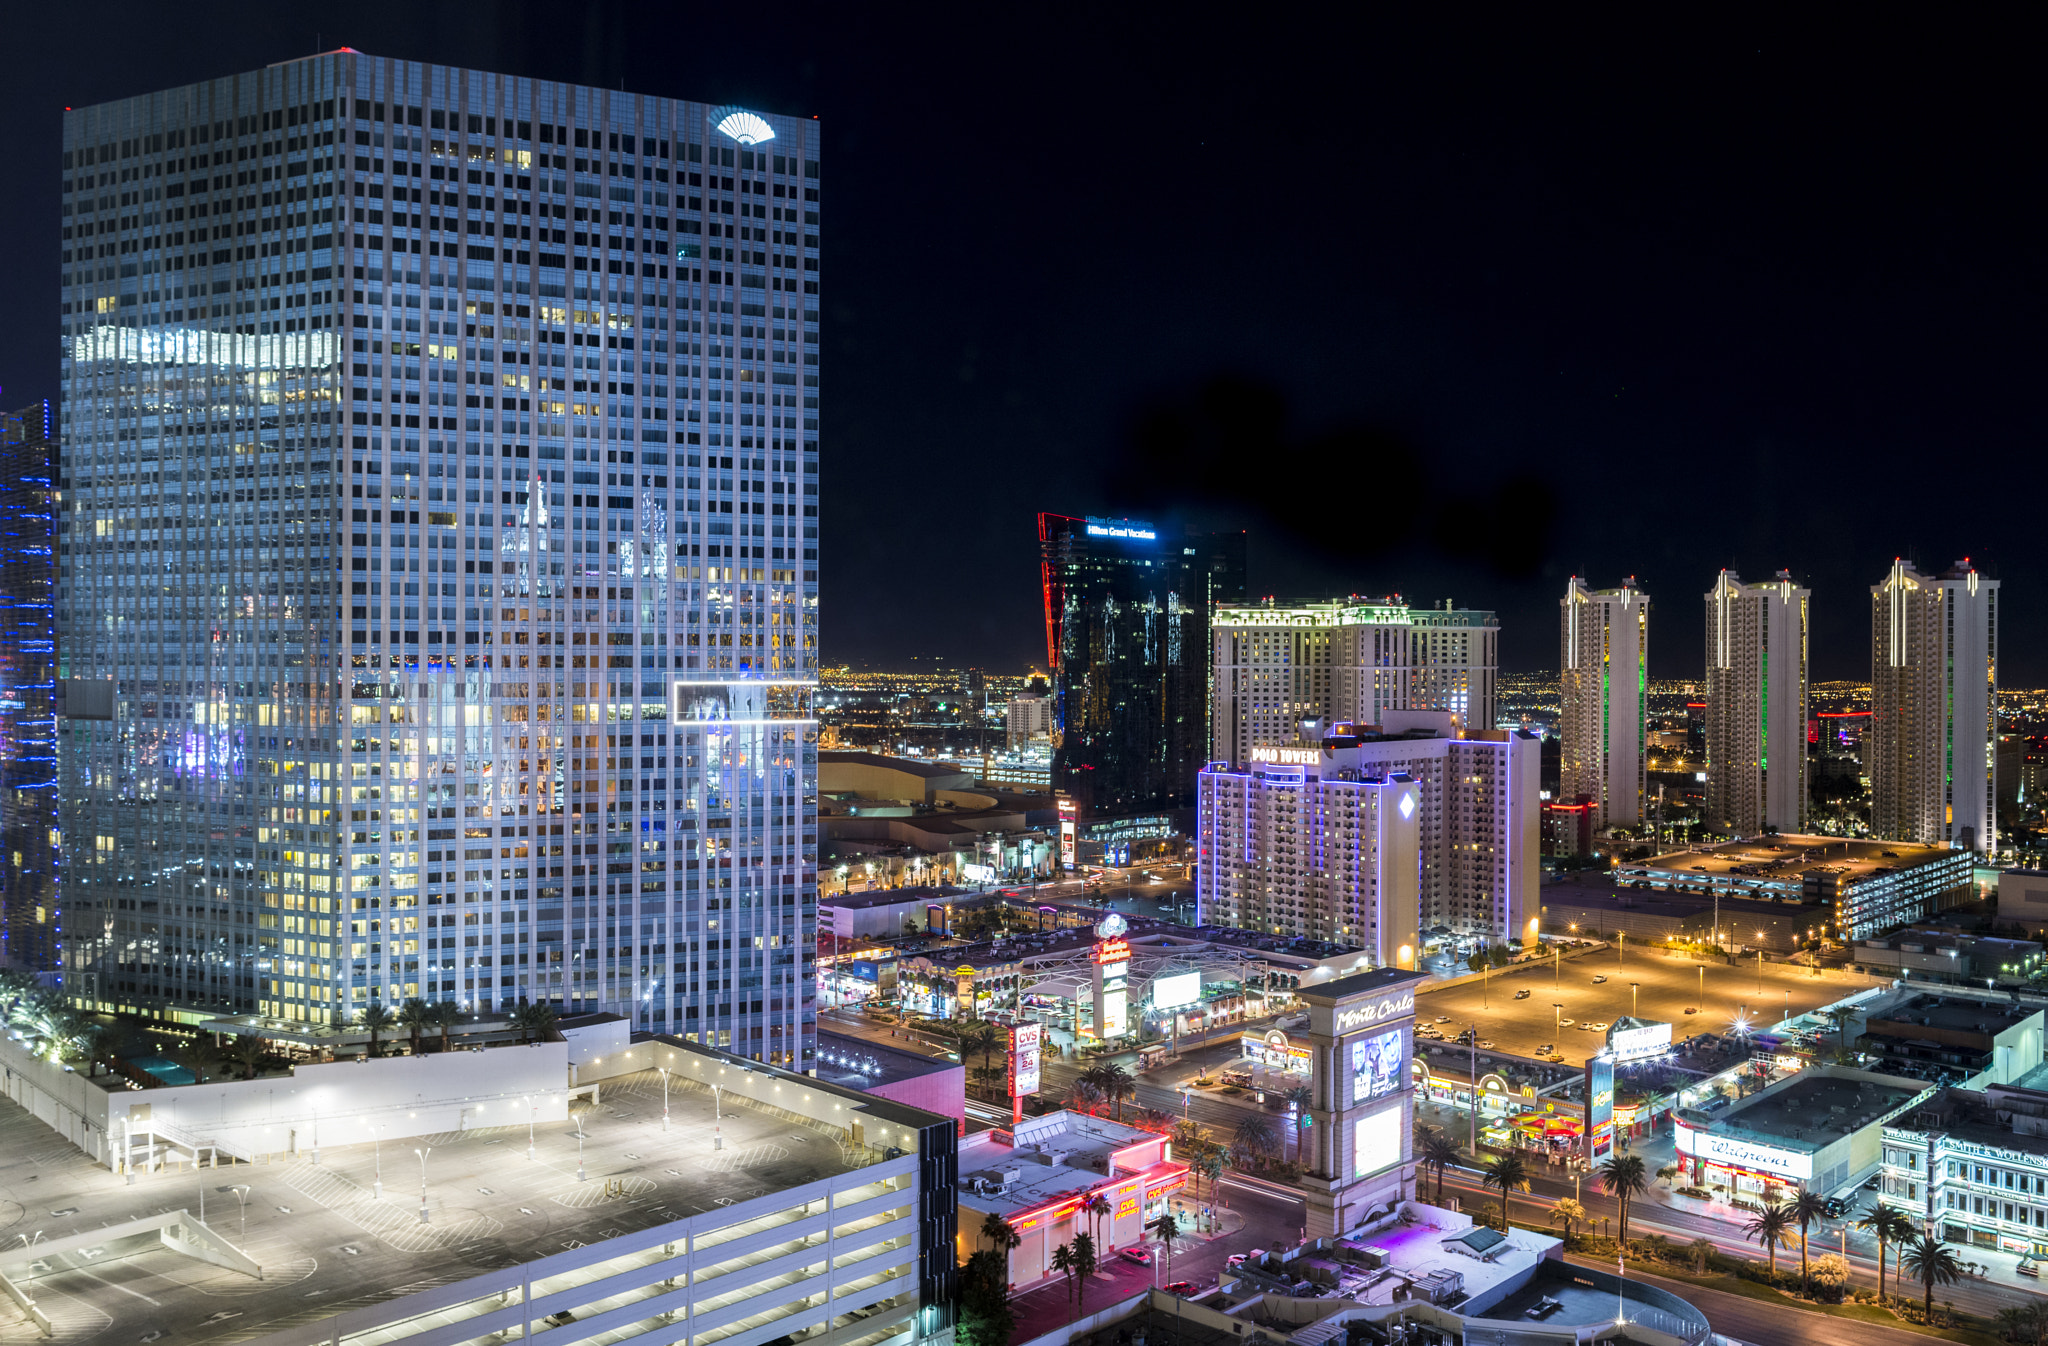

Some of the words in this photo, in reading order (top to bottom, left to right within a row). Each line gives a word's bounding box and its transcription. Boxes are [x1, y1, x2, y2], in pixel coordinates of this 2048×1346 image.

[1087, 525, 1109, 536] Hilton
[1109, 527, 1128, 537] Grand
[1127, 528, 1156, 540] Vacations
[1252, 748, 1278, 762] POLO
[1279, 749, 1320, 765] TOWERS
[1336, 1004, 1377, 1031] Monte
[1377, 994, 1414, 1020] Carlo
[1019, 1030, 1038, 1044] CVS
[1022, 1059, 1034, 1069] 24
[1886, 1131, 1911, 1139] STEAKS
[1710, 1140, 1790, 1168] Walgreens
[1949, 1140, 1980, 1155] SMITH
[1984, 1148, 1992, 1157] &
[1147, 1180, 1186, 1199] CVS/pharmacy
[1120, 1198, 1135, 1210] CVS
[1115, 1206, 1140, 1221] pharmacy
[1022, 1219, 1037, 1230] Photo
